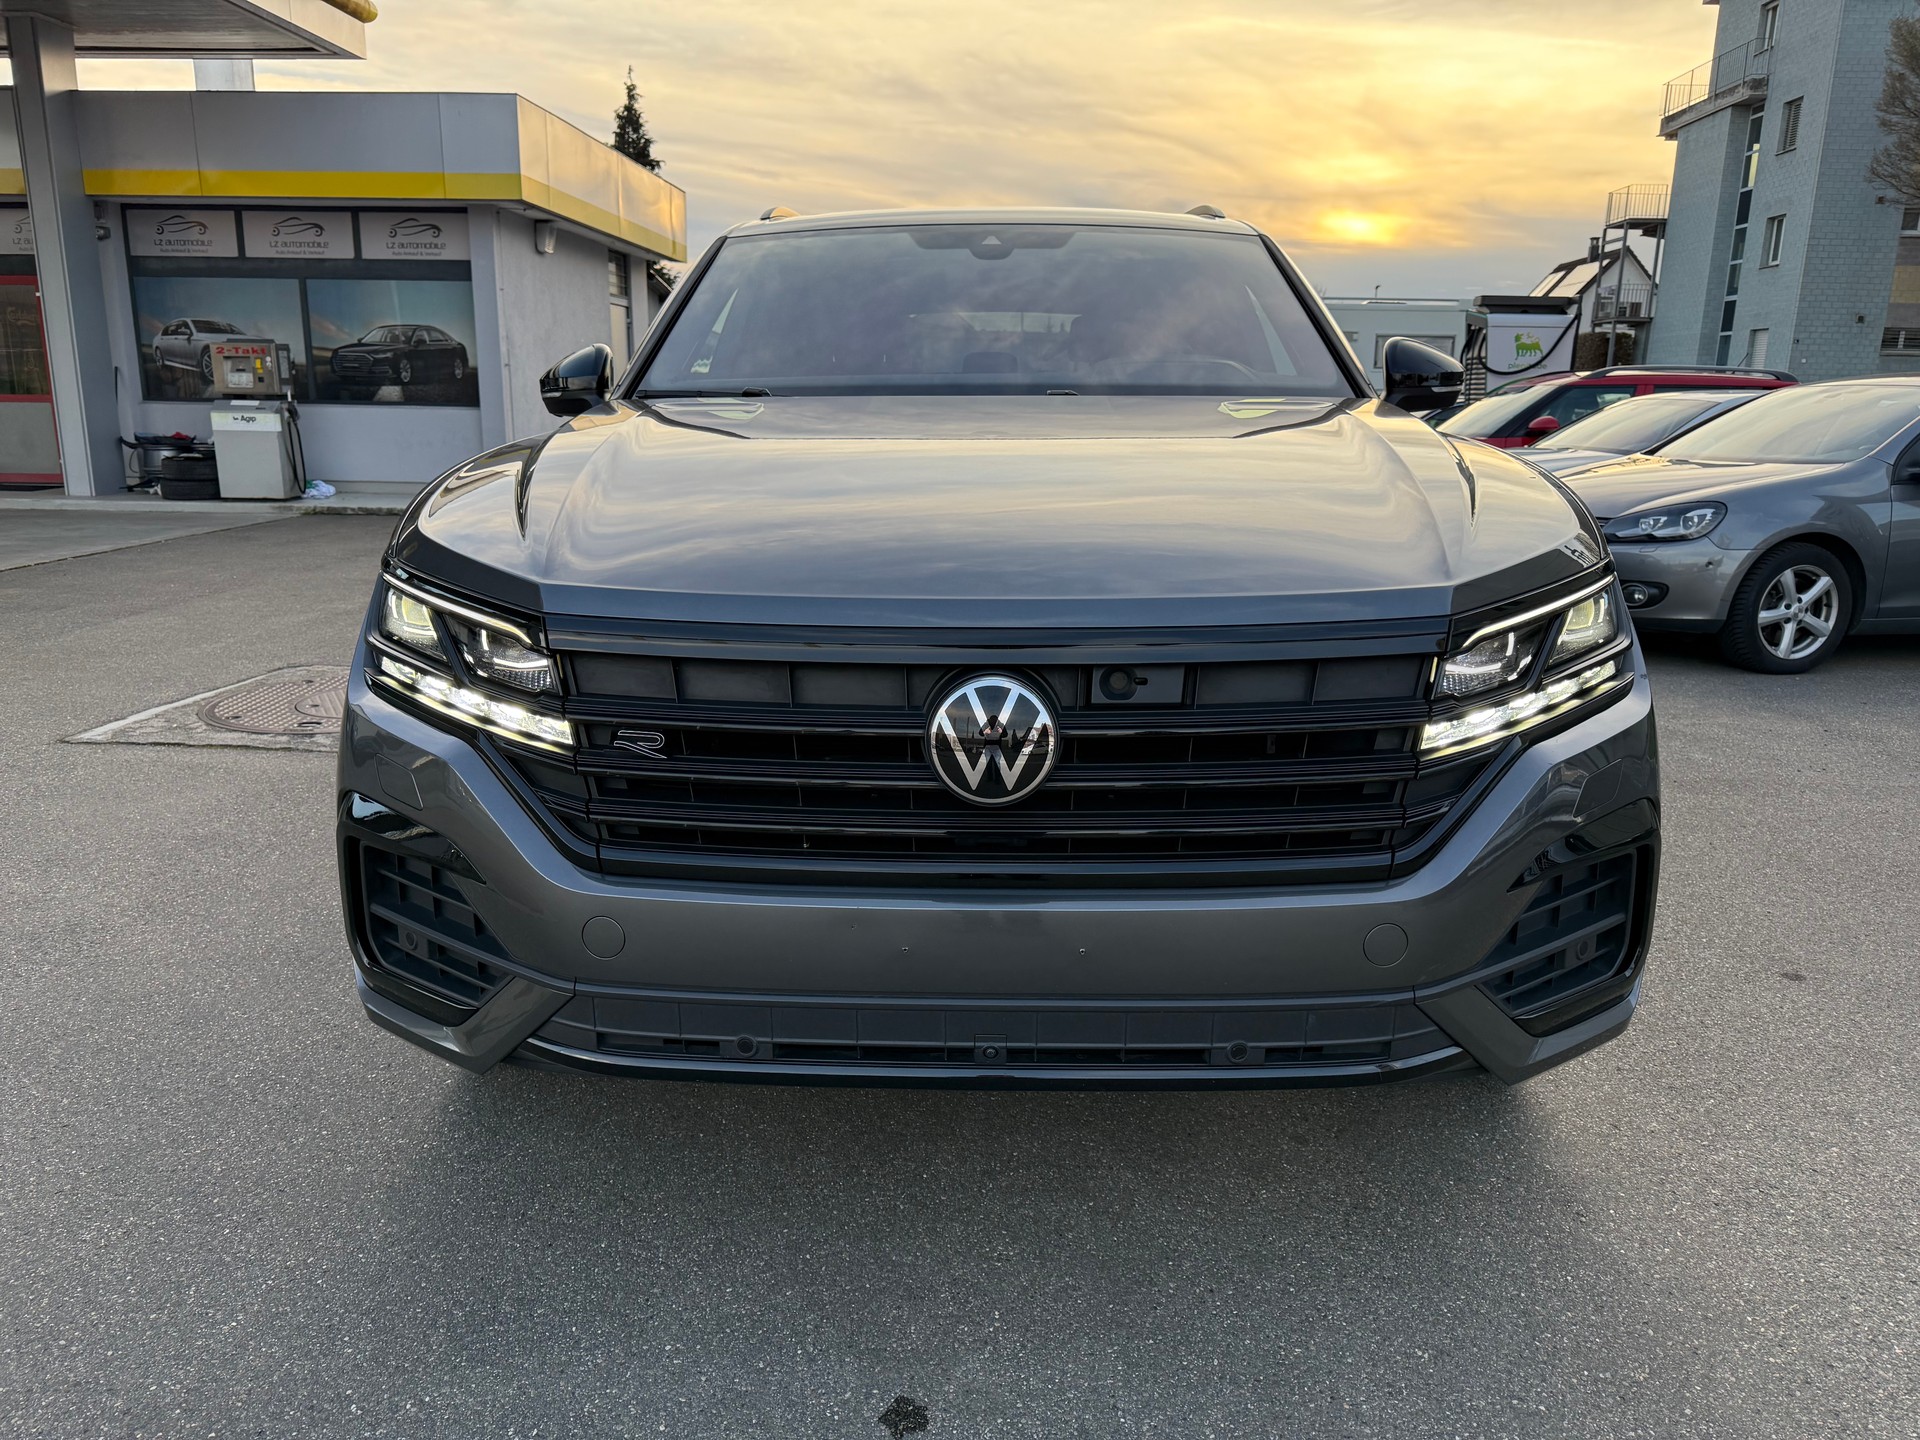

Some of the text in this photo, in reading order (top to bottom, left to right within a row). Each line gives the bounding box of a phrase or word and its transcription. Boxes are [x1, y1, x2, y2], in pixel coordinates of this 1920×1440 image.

[153, 238, 163, 246] LZ
[269, 240, 279, 248] LZ
[385, 241, 396, 249] LZ
[216, 346, 267, 354] 2-Takt
[240, 415, 257, 423] Agip
